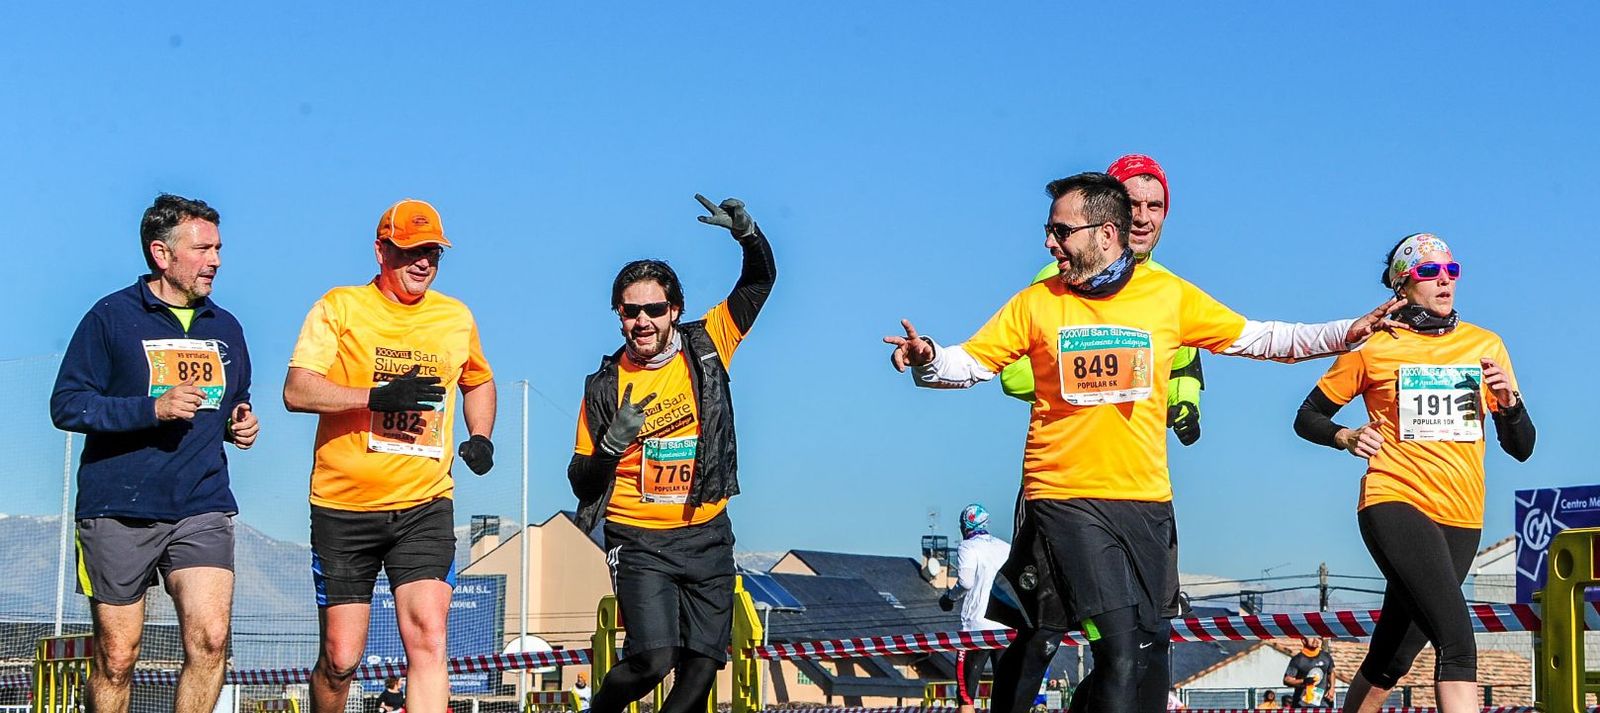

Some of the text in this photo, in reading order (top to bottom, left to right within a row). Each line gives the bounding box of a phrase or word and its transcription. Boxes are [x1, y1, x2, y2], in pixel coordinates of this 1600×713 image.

[1091, 328, 1109, 336] San
[414, 350, 438, 363] San
[1074, 354, 1118, 379] 849
[178, 361, 212, 382] 838
[663, 393, 686, 408] San
[1413, 395, 1451, 415] 191
[382, 410, 421, 432] 882
[639, 403, 691, 435] ilvestre
[1412, 418, 1442, 426] POPULAR
[653, 464, 691, 484] 776
[1561, 499, 1587, 509] Centro
